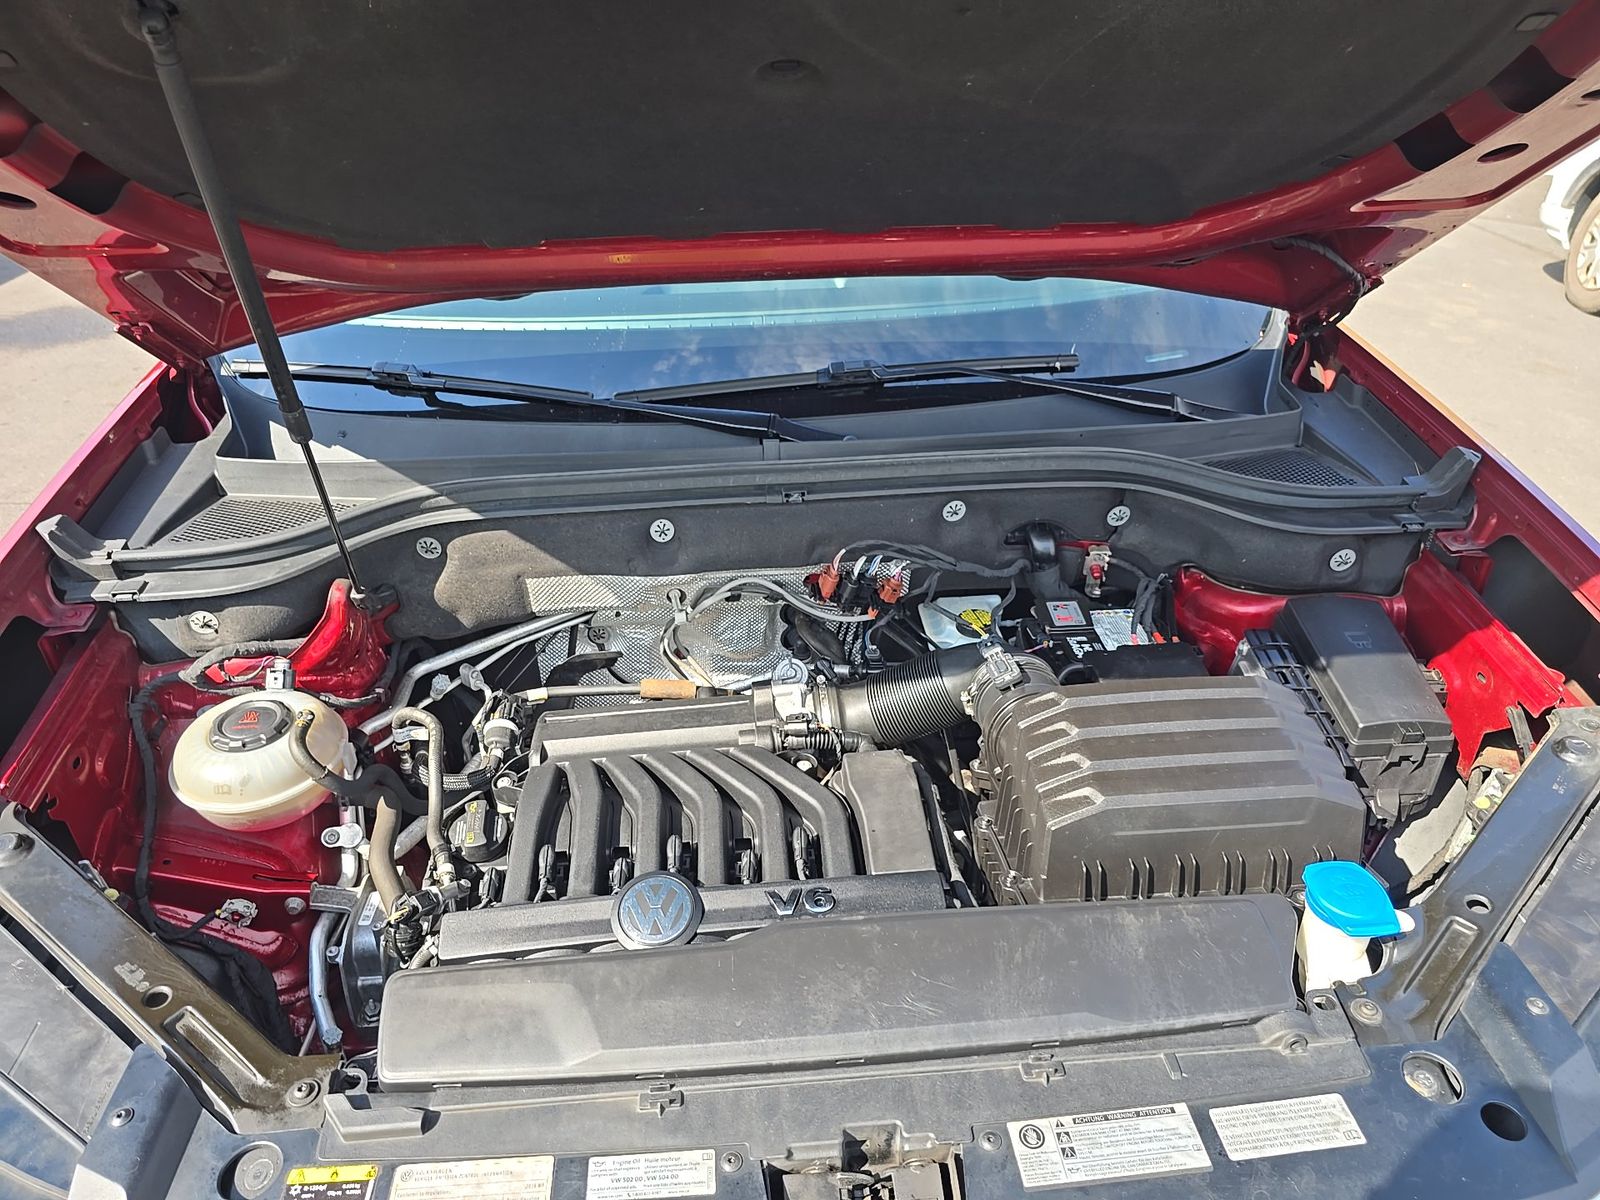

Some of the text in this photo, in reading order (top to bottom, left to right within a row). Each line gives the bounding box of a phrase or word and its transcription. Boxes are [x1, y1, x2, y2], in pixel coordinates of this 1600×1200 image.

[765, 886, 836, 916] V6
[1074, 1107, 1171, 1123] ACHTUNG WARNING ATTENTION
[660, 1155, 680, 1163] moteur
